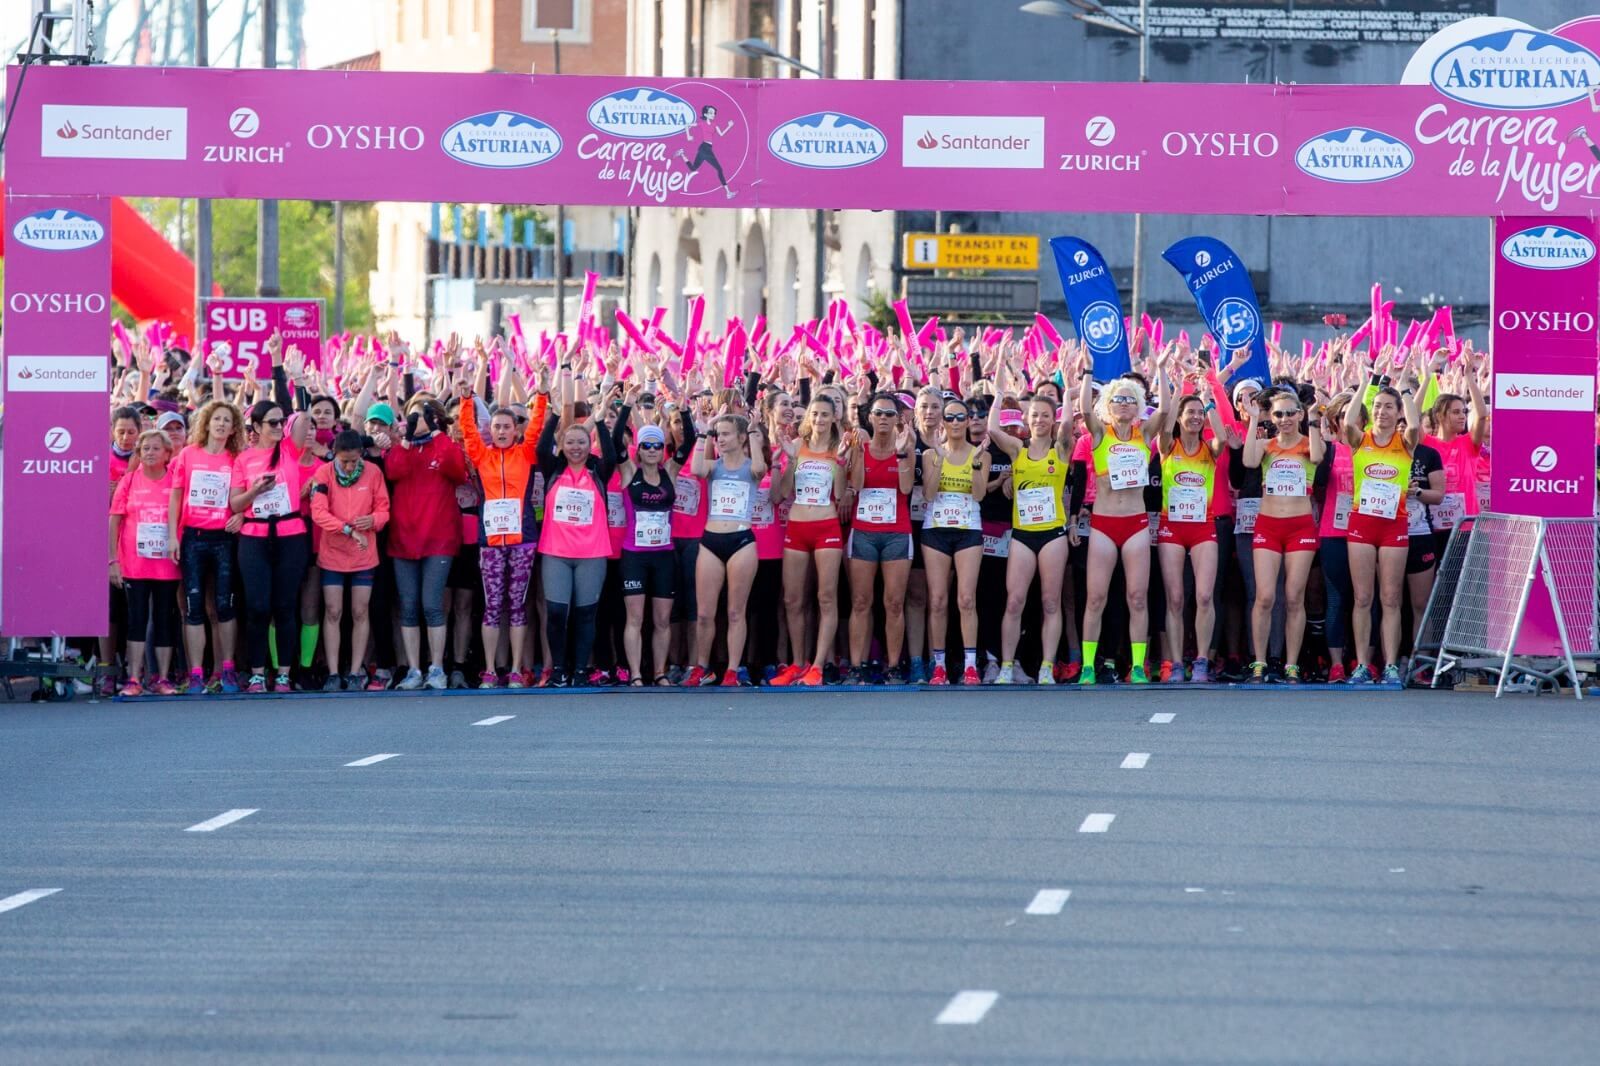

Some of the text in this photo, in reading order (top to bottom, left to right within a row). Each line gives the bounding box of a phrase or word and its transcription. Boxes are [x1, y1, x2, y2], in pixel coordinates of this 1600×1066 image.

[1471, 57, 1587, 65] CENTRAL LECHERA
[1444, 58, 1591, 88] ASTURIANA
[596, 105, 687, 125] ASTURIANA
[81, 124, 173, 141] Santander
[1415, 103, 1558, 146] Carrera
[307, 124, 425, 151] OYSHO
[451, 131, 553, 154] ASTURIANA
[778, 132, 878, 154] ASTURIANA
[941, 134, 1030, 150] Santander
[1162, 131, 1279, 157] OYSHO
[203, 146, 284, 163] ZURICH
[577, 133, 667, 161] Carrera
[1059, 154, 1140, 171] ZURICH
[1305, 147, 1404, 168] ASTURIANA
[598, 159, 699, 203] de la Mujer
[1448, 142, 1600, 211] de la Mujer
[20, 223, 98, 240] ASTURIANA
[945, 239, 1028, 250] TRANSIT EN
[1509, 241, 1588, 258] ASTURIANA
[945, 254, 1030, 264] TEMPS REAL
[1068, 265, 1105, 286] ZURICH
[1193, 259, 1234, 290] ZURICH
[10, 292, 105, 313] OYSHO
[210, 307, 268, 332] SUB
[1499, 310, 1594, 332] OYSHO
[282, 329, 319, 339] OYSHO
[34, 368, 97, 380] Santander
[1522, 386, 1584, 398] Santander
[22, 460, 93, 474] ZURICH
[1121, 468, 1138, 477] 016
[201, 487, 218, 496] 016
[805, 486, 820, 494] 016
[1277, 484, 1294, 492] 016
[1509, 478, 1578, 494] ZURICH
[264, 501, 280, 510] 016
[720, 496, 737, 504] 016
[868, 504, 884, 512] 016
[1179, 502, 1195, 511] 016
[1370, 496, 1387, 506] 016
[944, 508, 960, 516] 016
[1027, 504, 1044, 513] 016
[1438, 510, 1454, 518] 016
[493, 515, 510, 523] 016
[148, 539, 165, 547] 016
